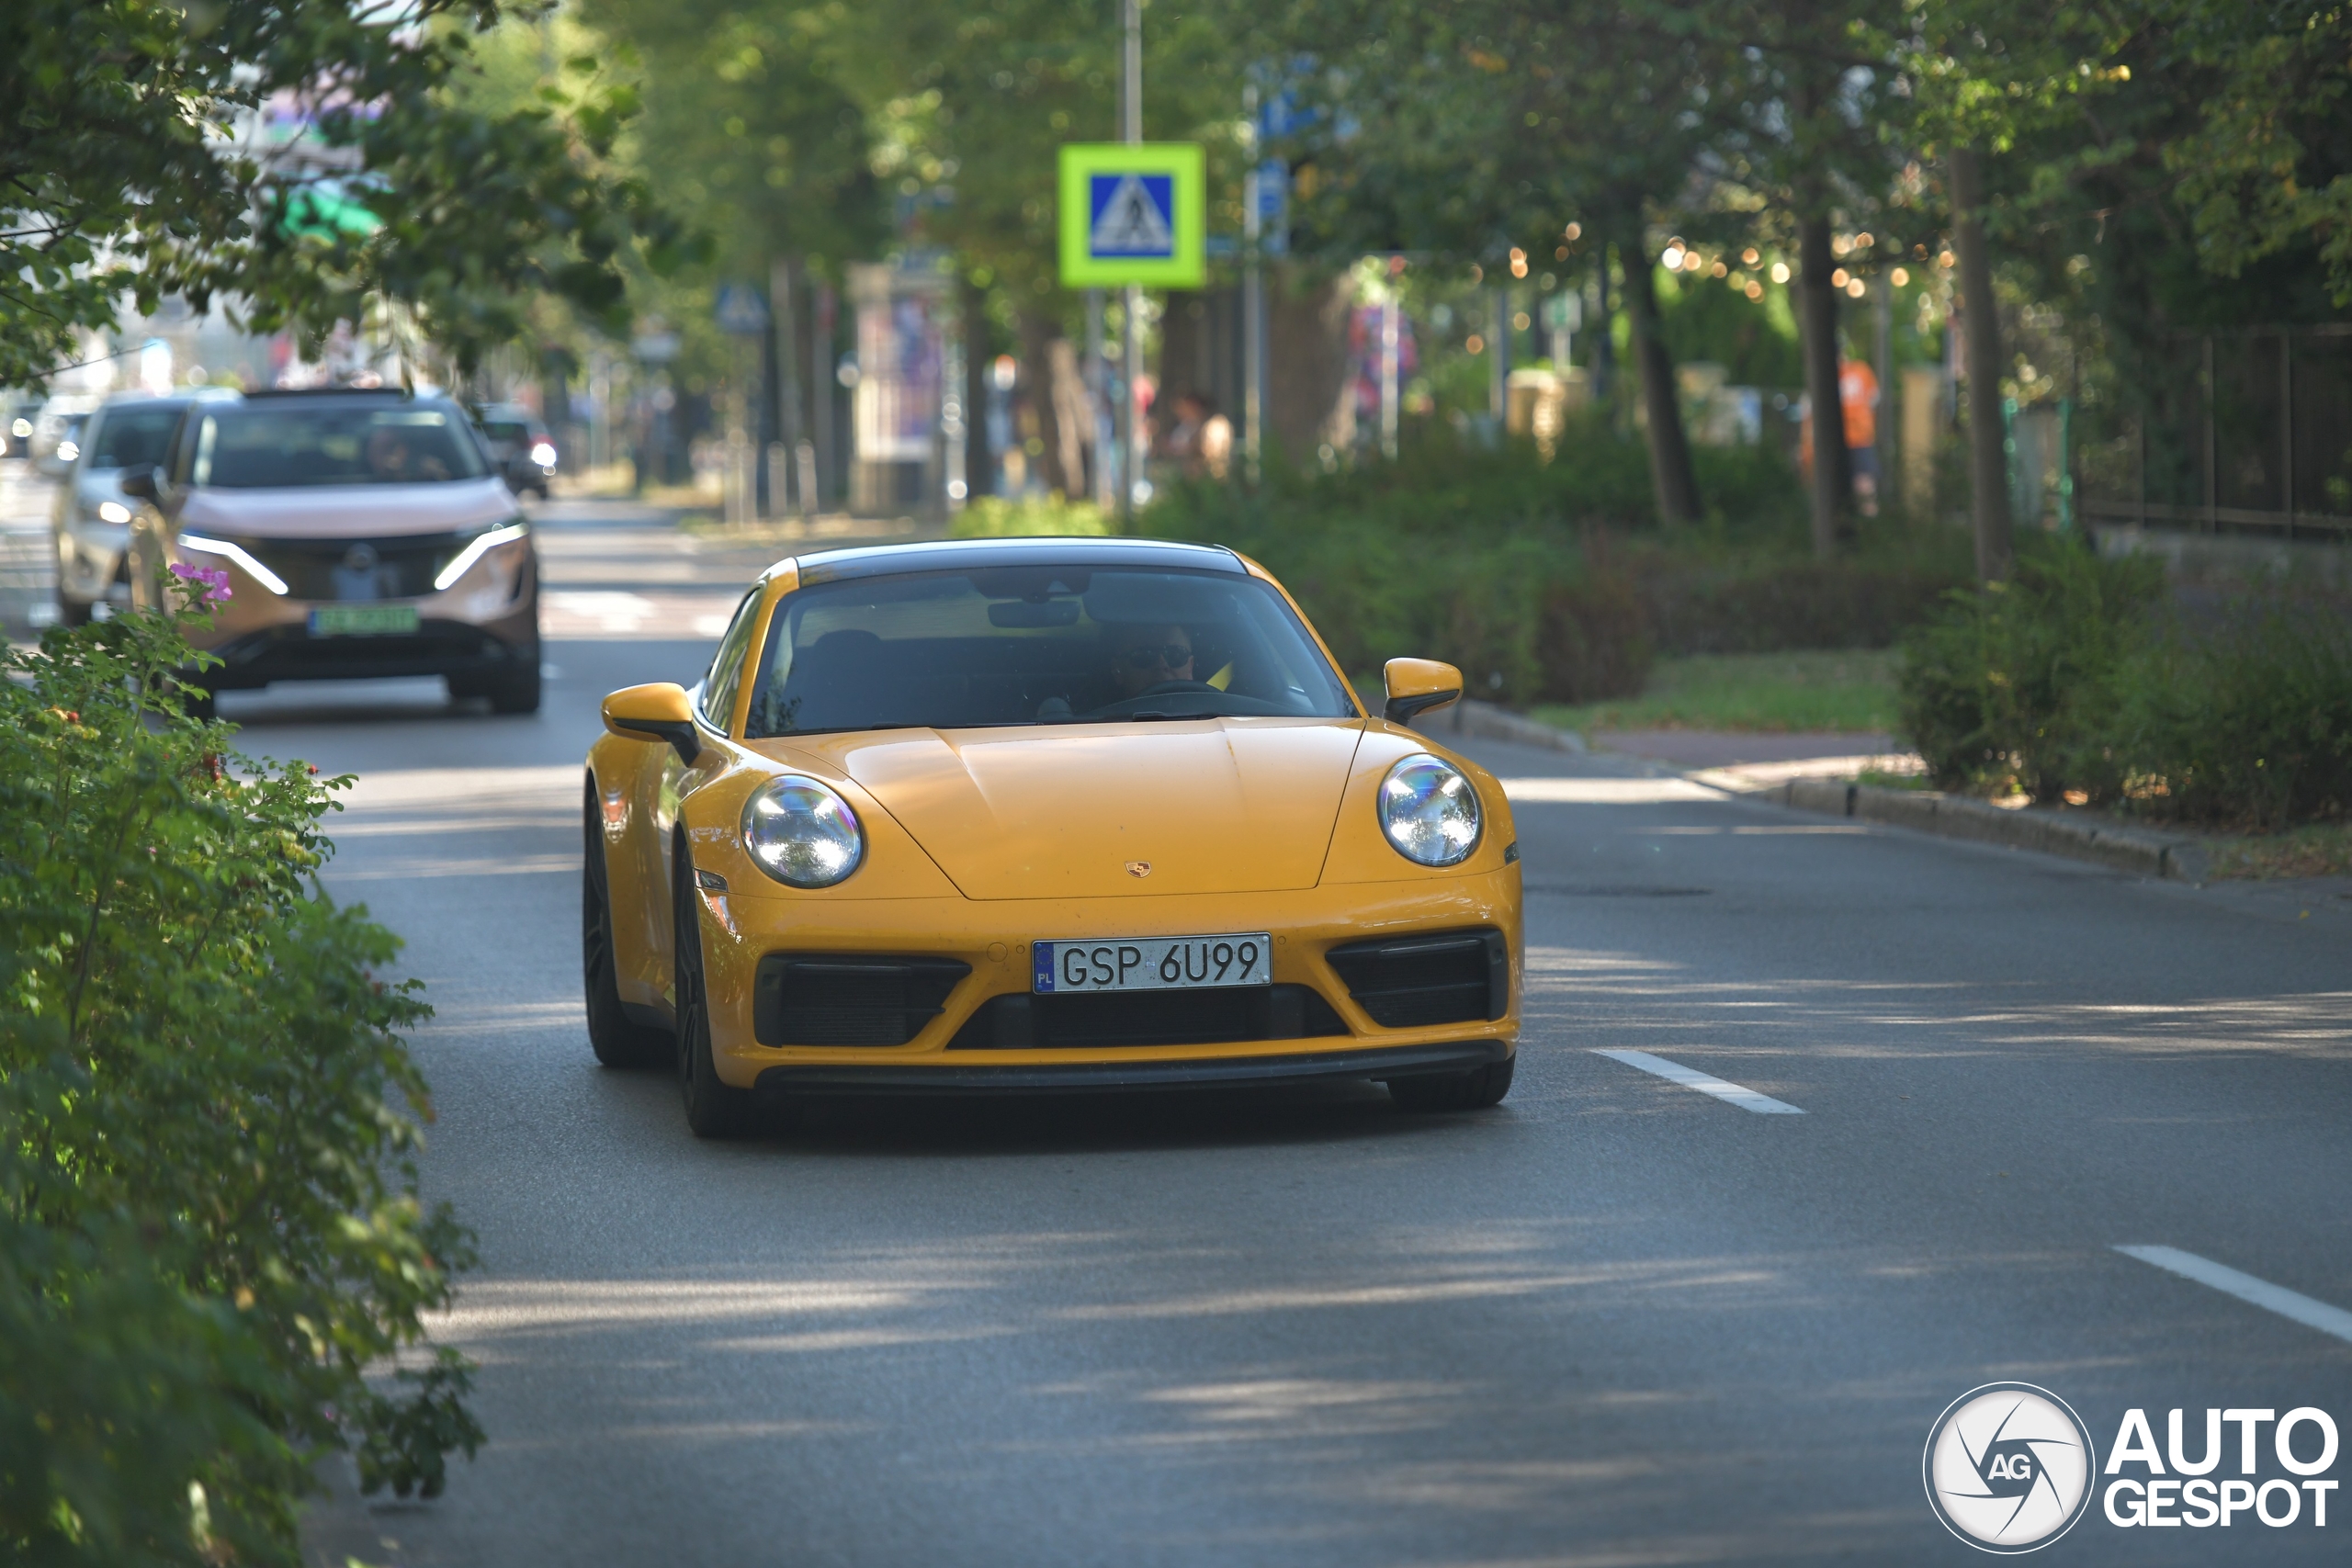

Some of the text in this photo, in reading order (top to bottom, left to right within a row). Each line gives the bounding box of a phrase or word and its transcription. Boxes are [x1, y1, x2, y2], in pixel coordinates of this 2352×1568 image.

[1063, 941, 1259, 986] GSP 6U99
[1037, 974, 1052, 985] PL
